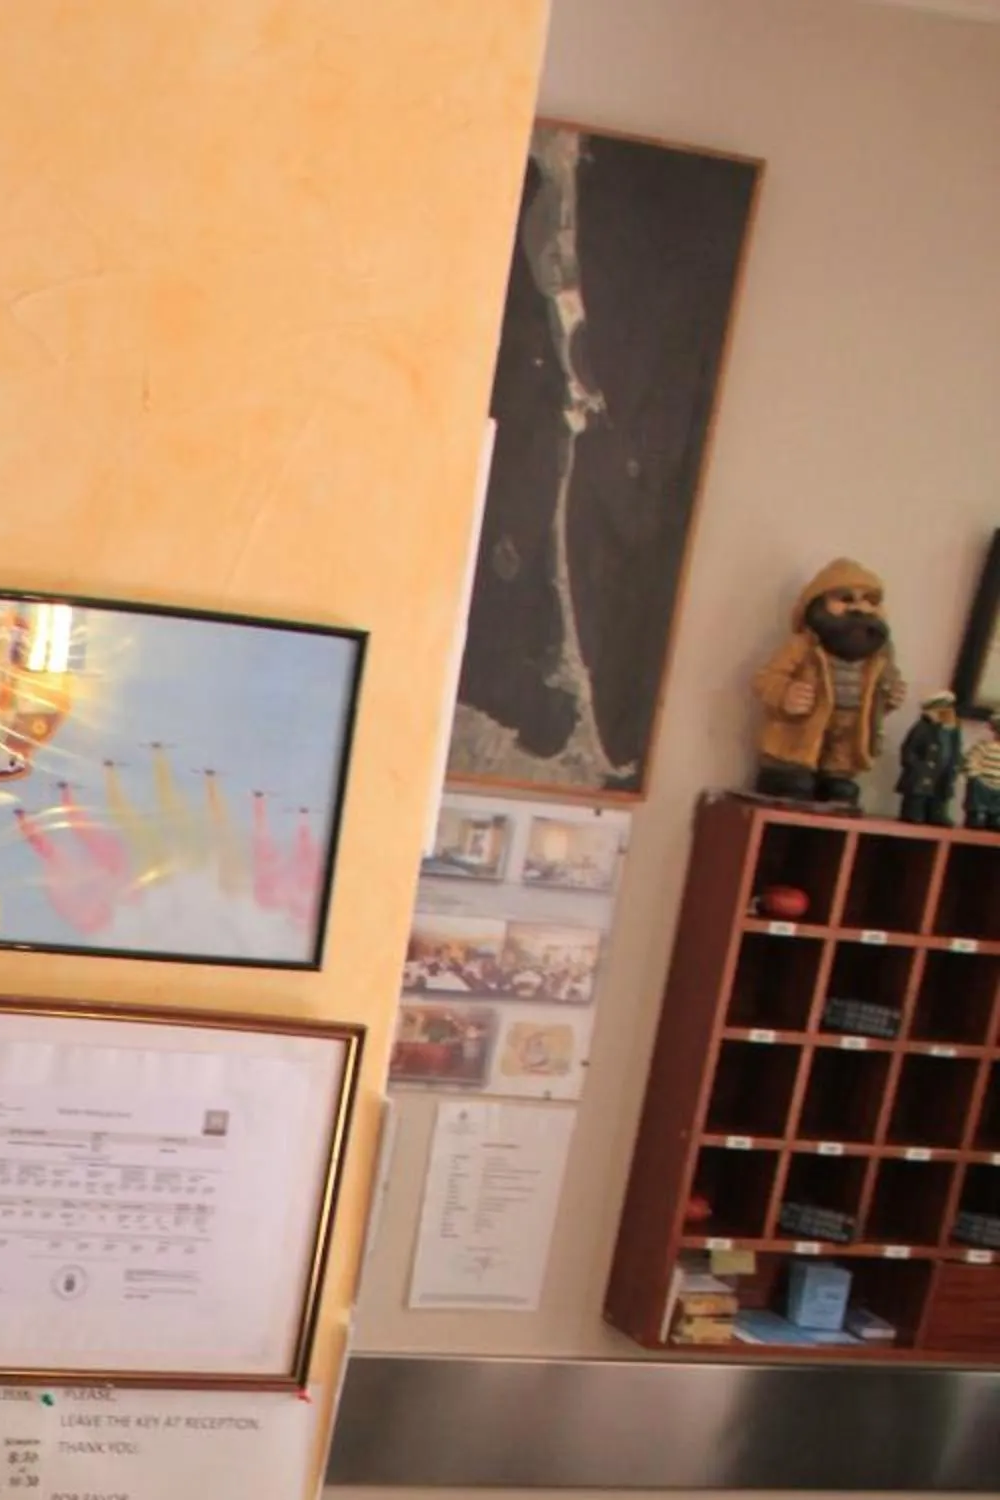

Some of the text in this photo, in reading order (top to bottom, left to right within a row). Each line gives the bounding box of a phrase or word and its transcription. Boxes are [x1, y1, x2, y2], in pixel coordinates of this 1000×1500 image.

[60, 1414, 101, 1428] LEAVE
[106, 1415, 131, 1428] THE
[136, 1416, 161, 1429] KEY
[164, 1416, 182, 1429] AT
[57, 1441, 104, 1455] THANK
